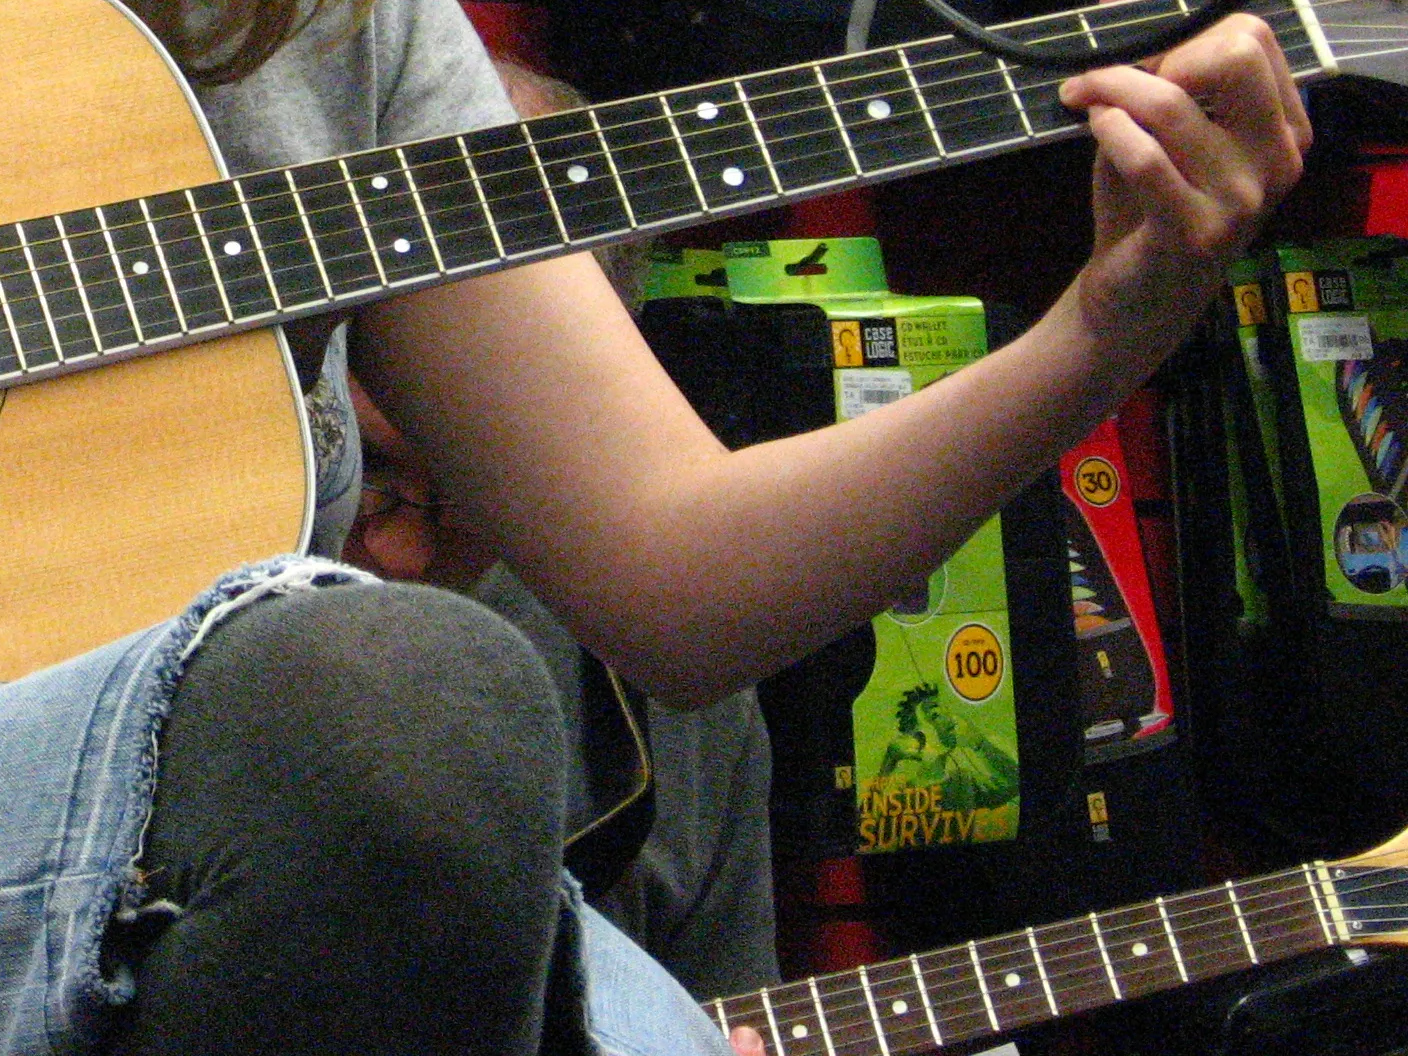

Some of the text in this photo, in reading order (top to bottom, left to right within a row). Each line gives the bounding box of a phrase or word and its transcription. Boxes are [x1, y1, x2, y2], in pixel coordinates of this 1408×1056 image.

[864, 327, 893, 341] case
[866, 341, 895, 359] LOGIC
[1082, 471, 1112, 493] 30
[955, 650, 999, 679] 100
[861, 785, 942, 819] INSIDE
[858, 805, 1009, 854] SURVIVES
